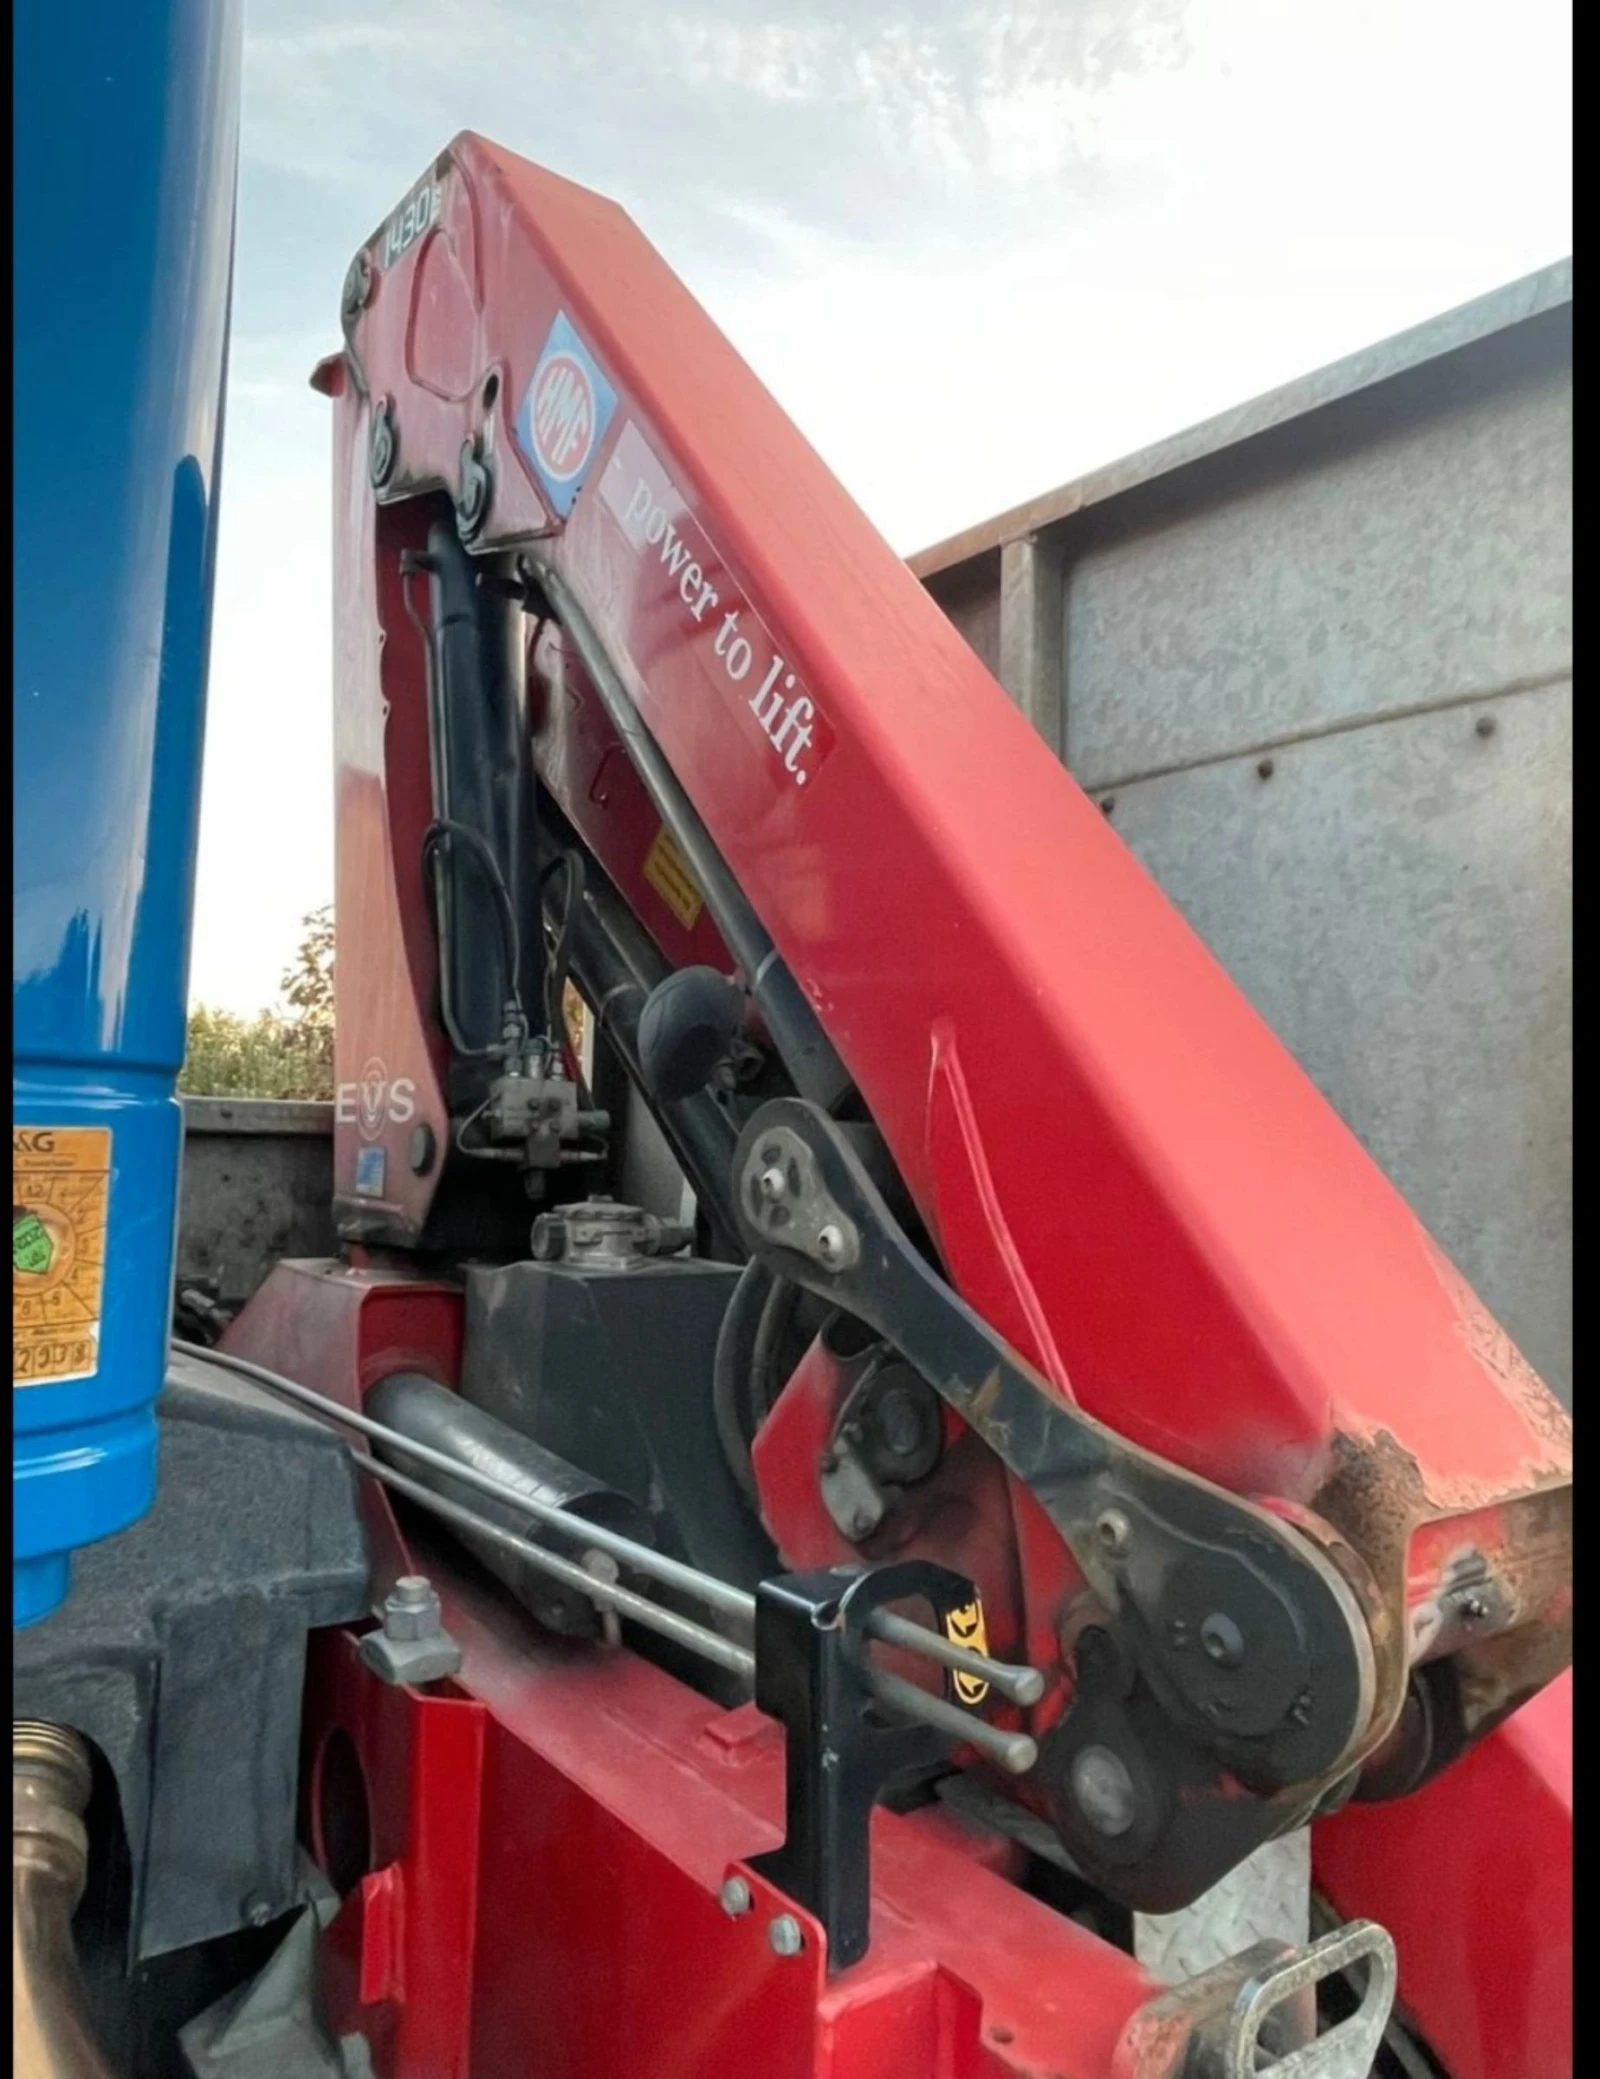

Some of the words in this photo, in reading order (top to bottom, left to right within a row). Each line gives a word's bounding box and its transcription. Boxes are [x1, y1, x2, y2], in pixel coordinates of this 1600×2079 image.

[384, 186, 432, 269] 1430
[537, 366, 588, 466] HMF
[624, 477, 719, 622] power
[713, 610, 753, 681] to
[747, 654, 815, 786] lift.
[335, 1076, 416, 1124] EVS
